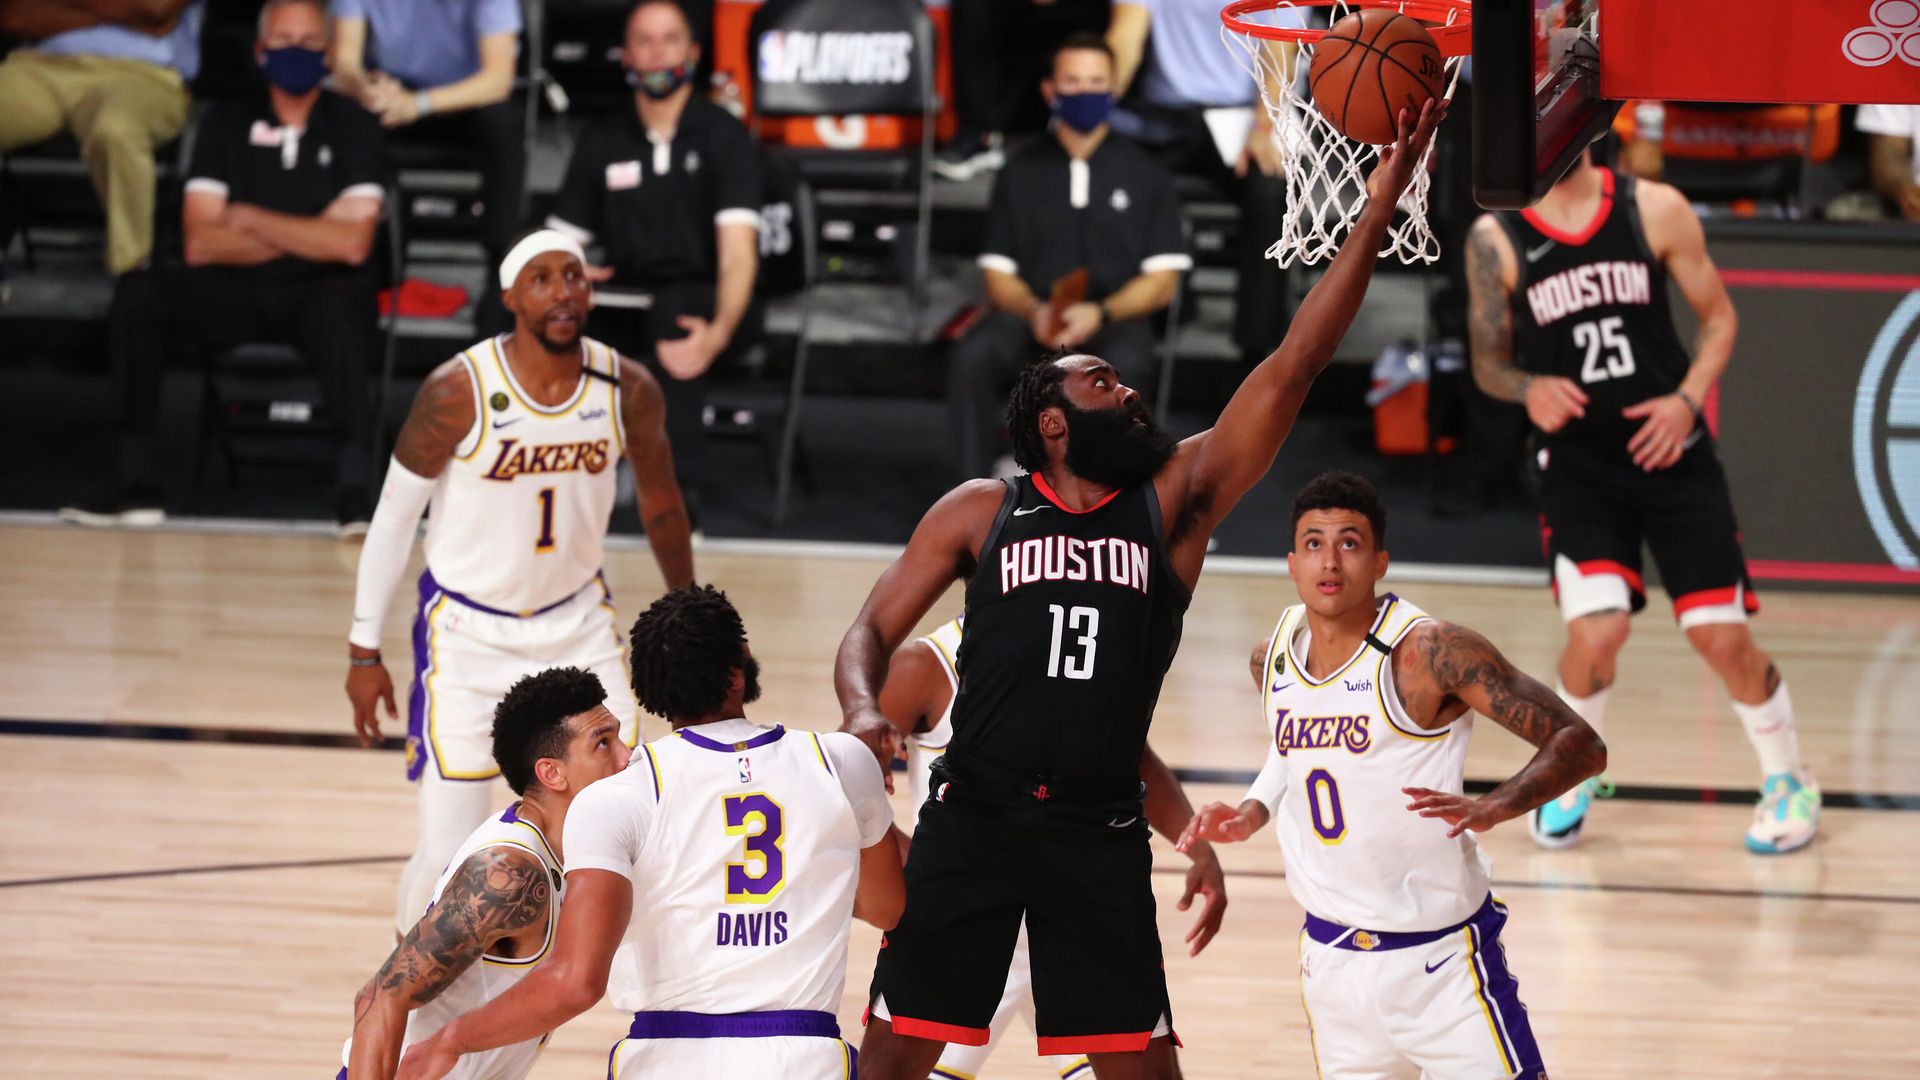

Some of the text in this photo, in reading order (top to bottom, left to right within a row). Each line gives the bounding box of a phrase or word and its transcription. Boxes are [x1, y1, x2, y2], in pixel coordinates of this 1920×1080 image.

[1526, 260, 1650, 327] HOUSTON
[1572, 315, 1636, 384] 25
[481, 438, 610, 482] LAKERS
[534, 486, 557, 554] 1
[1000, 534, 1150, 595] HOUSTON
[1047, 603, 1099, 680] 13
[1344, 678, 1372, 692] wish
[1275, 707, 1371, 758] LAKERS
[1304, 767, 1348, 846] 0
[721, 791, 785, 904] 3
[716, 911, 788, 947] DAVIS
